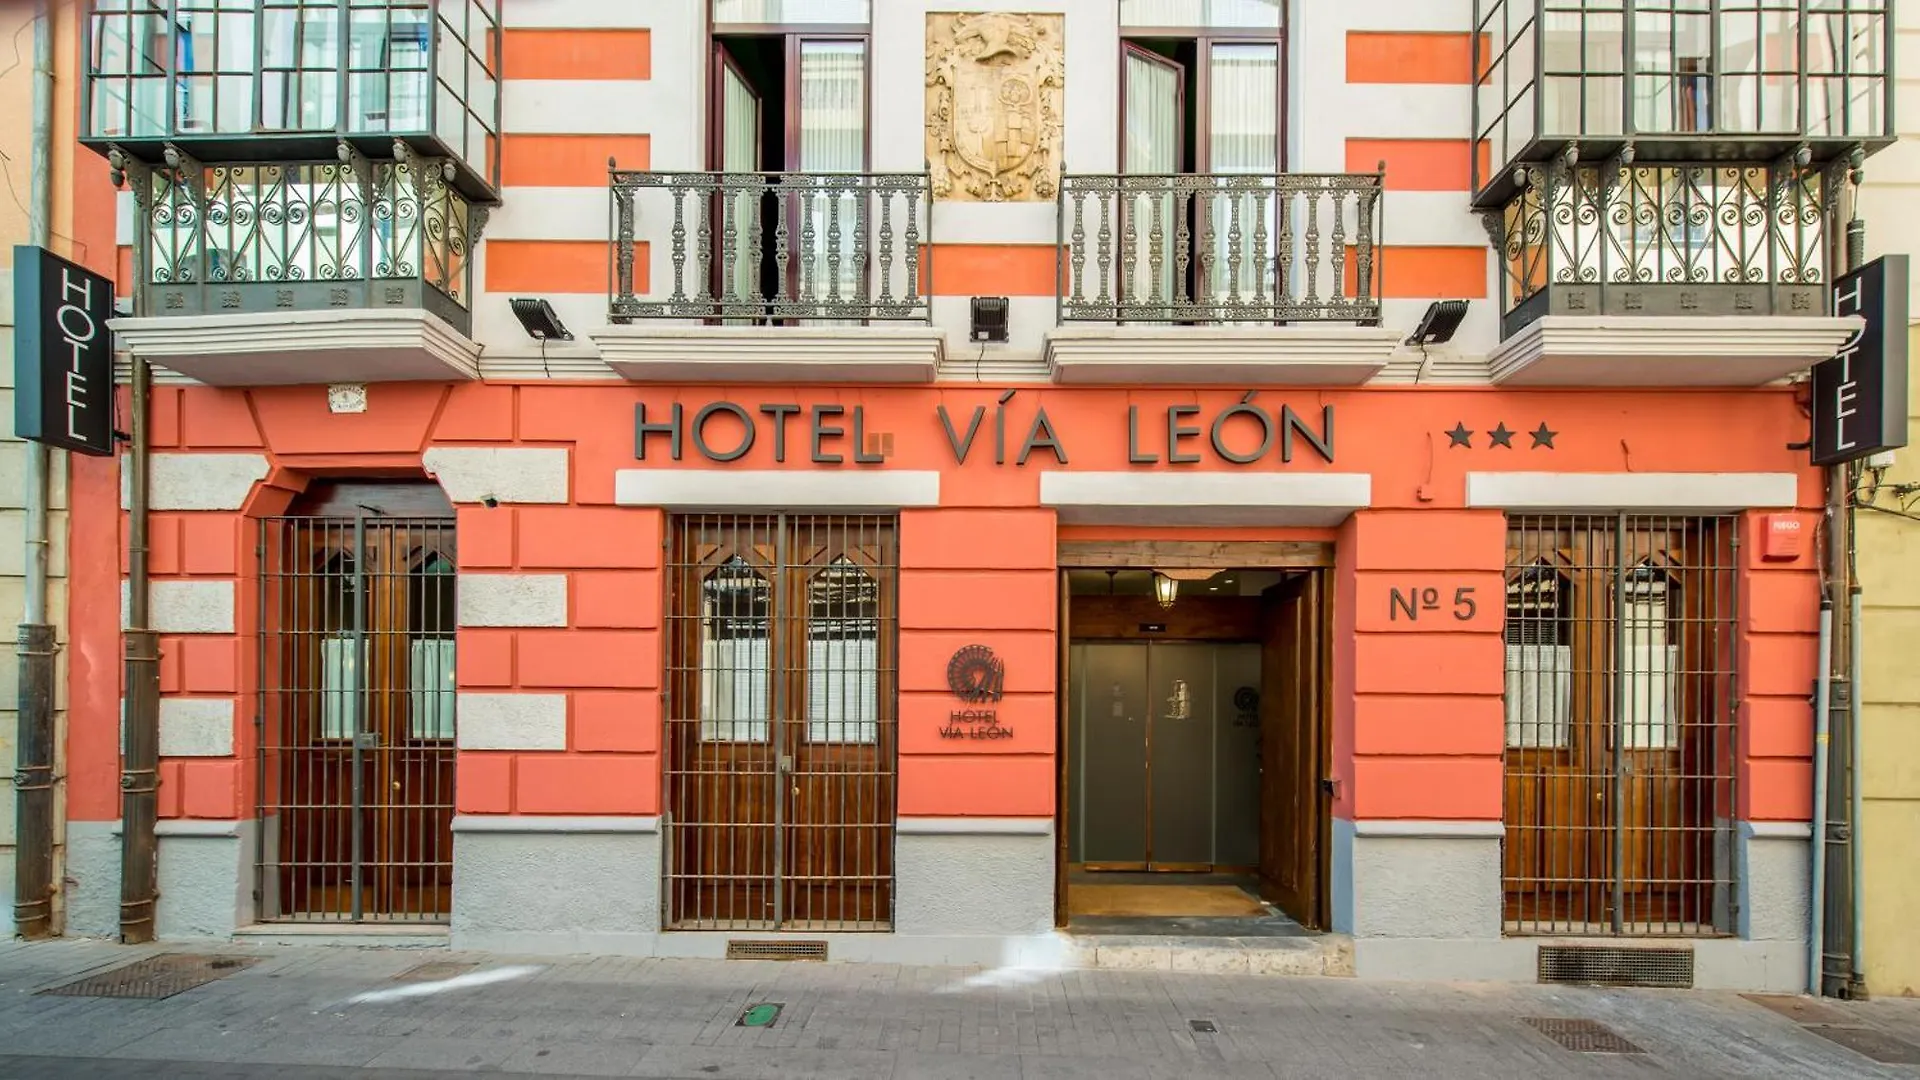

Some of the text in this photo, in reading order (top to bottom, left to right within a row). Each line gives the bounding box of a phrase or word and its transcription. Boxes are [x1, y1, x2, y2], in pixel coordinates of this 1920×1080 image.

[56, 267, 95, 441] HOTEL
[633, 389, 1335, 466] HOTEL VÍA LEÓN
[1453, 587, 1477, 621] 5
[950, 709, 1000, 723] HOTEL
